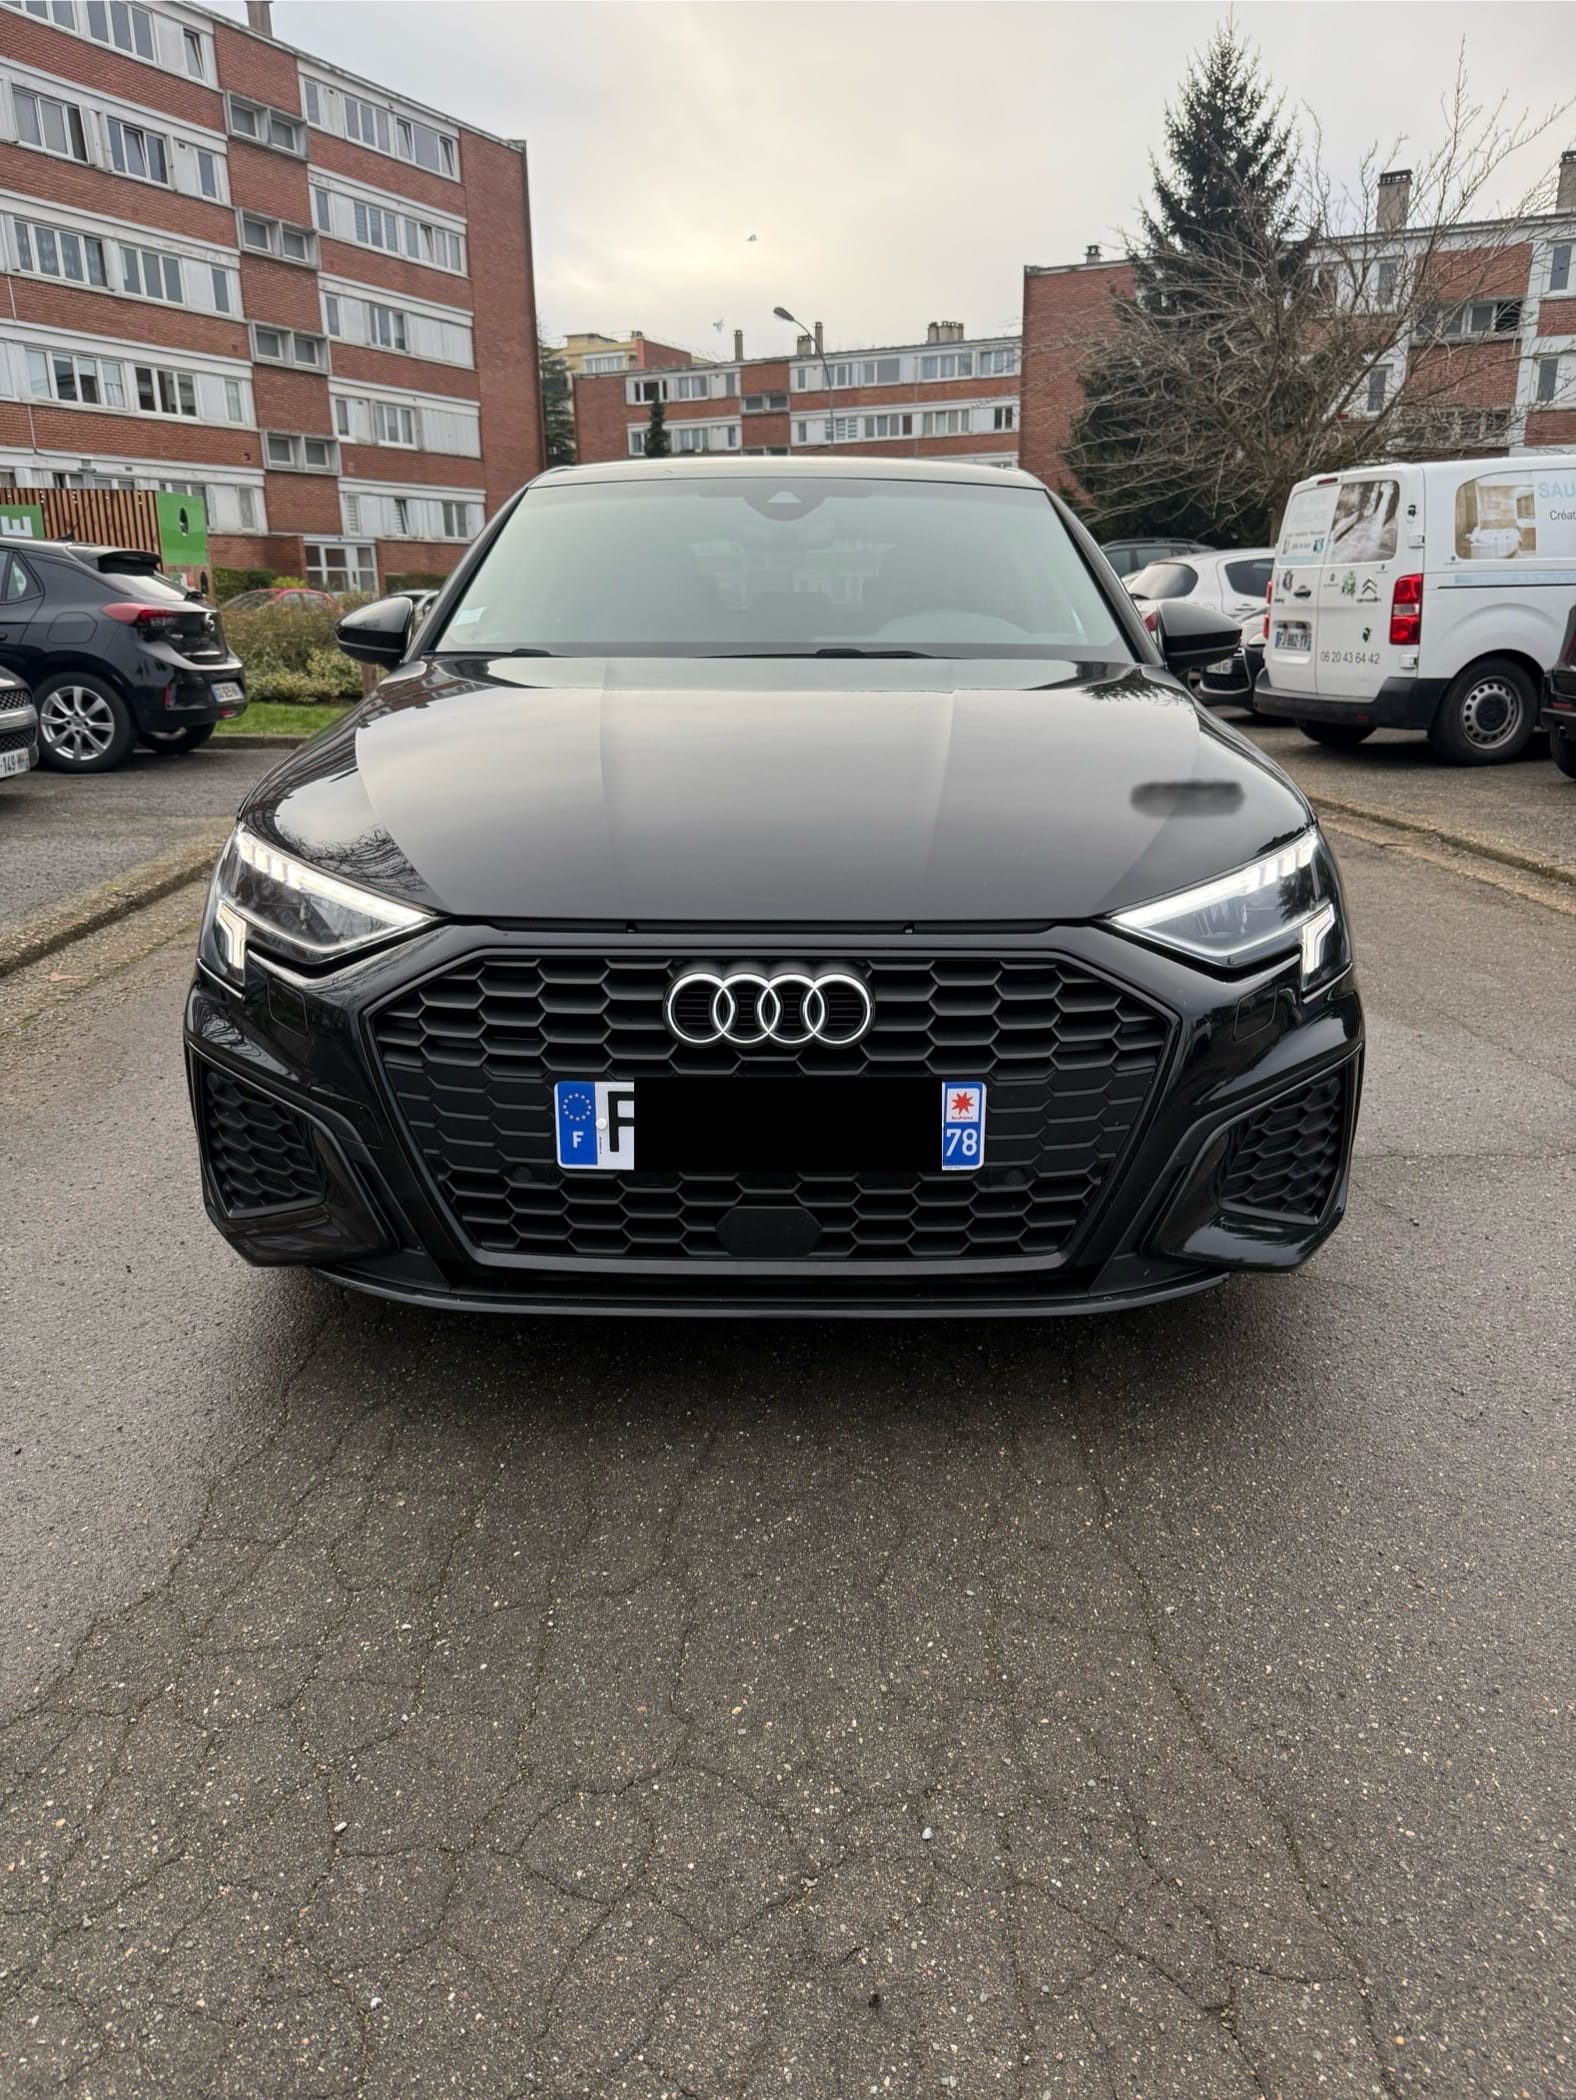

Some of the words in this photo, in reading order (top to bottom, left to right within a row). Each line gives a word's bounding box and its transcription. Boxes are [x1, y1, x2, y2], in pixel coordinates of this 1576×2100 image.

[1320, 650, 1330, 663] 06
[1331, 650, 1342, 663] 20
[1342, 651, 1353, 664] 43
[1354, 652, 1367, 664] 64
[1367, 652, 1380, 665] 42
[573, 1131, 584, 1149] F
[946, 1128, 978, 1157] 78
